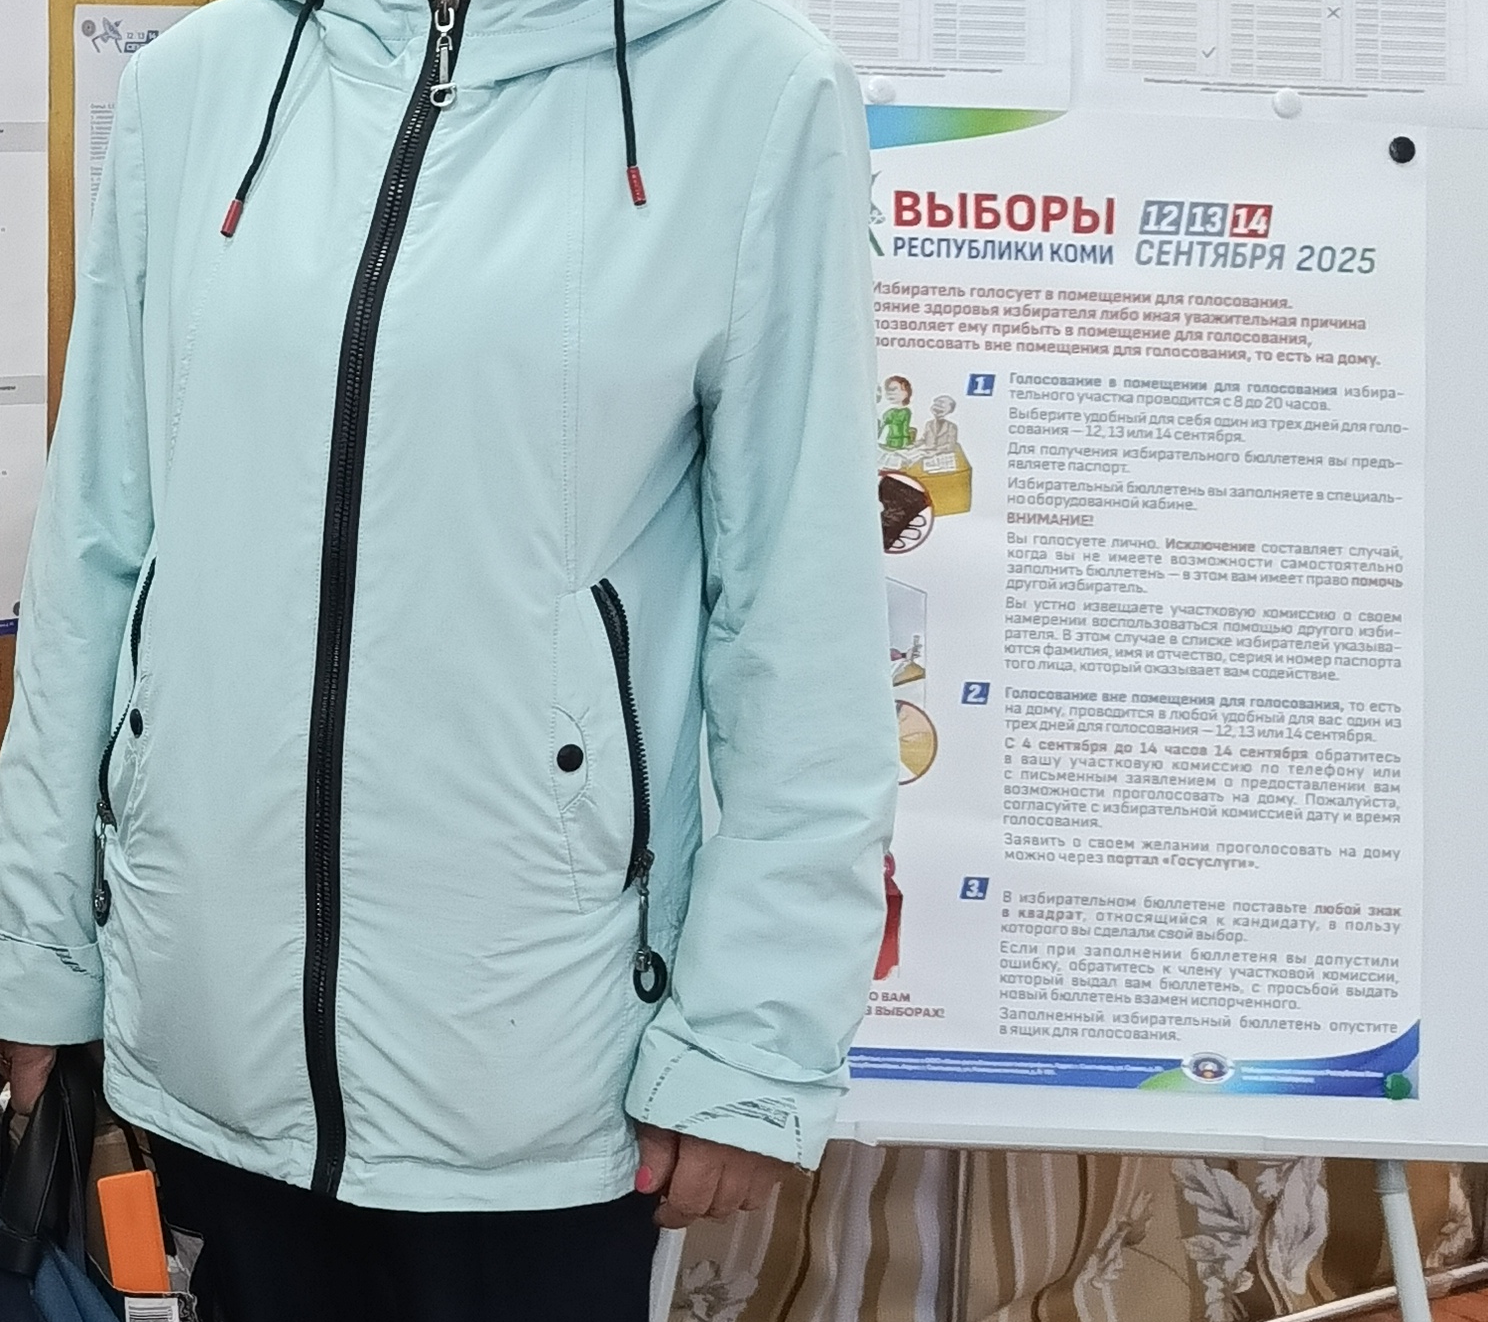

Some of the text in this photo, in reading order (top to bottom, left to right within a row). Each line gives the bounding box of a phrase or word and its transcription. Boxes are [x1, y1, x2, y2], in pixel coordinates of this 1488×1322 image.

[893, 189, 1116, 235] ВЫБОРЫ
[1142, 204, 1268, 235] 12 13 14
[893, 236, 1114, 266] РЕСПУБЛИКИ КОМИ
[1135, 238, 1376, 274] СЕНТЯБРЯ 2025
[969, 285, 1042, 302] голосует
[1045, 289, 1054, 300] в
[1057, 289, 1151, 305] помещении
[1155, 293, 1184, 307] для
[1188, 294, 1293, 309] голосования.
[874, 300, 1367, 331] ояние здоровья избирателя либо иная уважительная причина
[958, 321, 987, 335] ему
[992, 320, 1061, 337] прибыть
[1064, 326, 1073, 337] в
[1077, 326, 1171, 342] помещение
[1174, 330, 1203, 343] для
[1207, 331, 1313, 348] голосования,
[984, 340, 1012, 352] вне
[1016, 340, 1109, 356] помещения
[1113, 345, 1141, 357] для
[1146, 345, 1252, 363] голосования,
[1255, 350, 1273, 362] то
[1276, 351, 1311, 363] есть
[1316, 353, 1334, 364] на
[1337, 353, 1382, 368] дому.
[1009, 371, 1102, 387] Голосование
[1108, 378, 1117, 388] в
[1123, 378, 1208, 392] помещении
[1213, 382, 1240, 394] для
[1247, 383, 1338, 396] голосования
